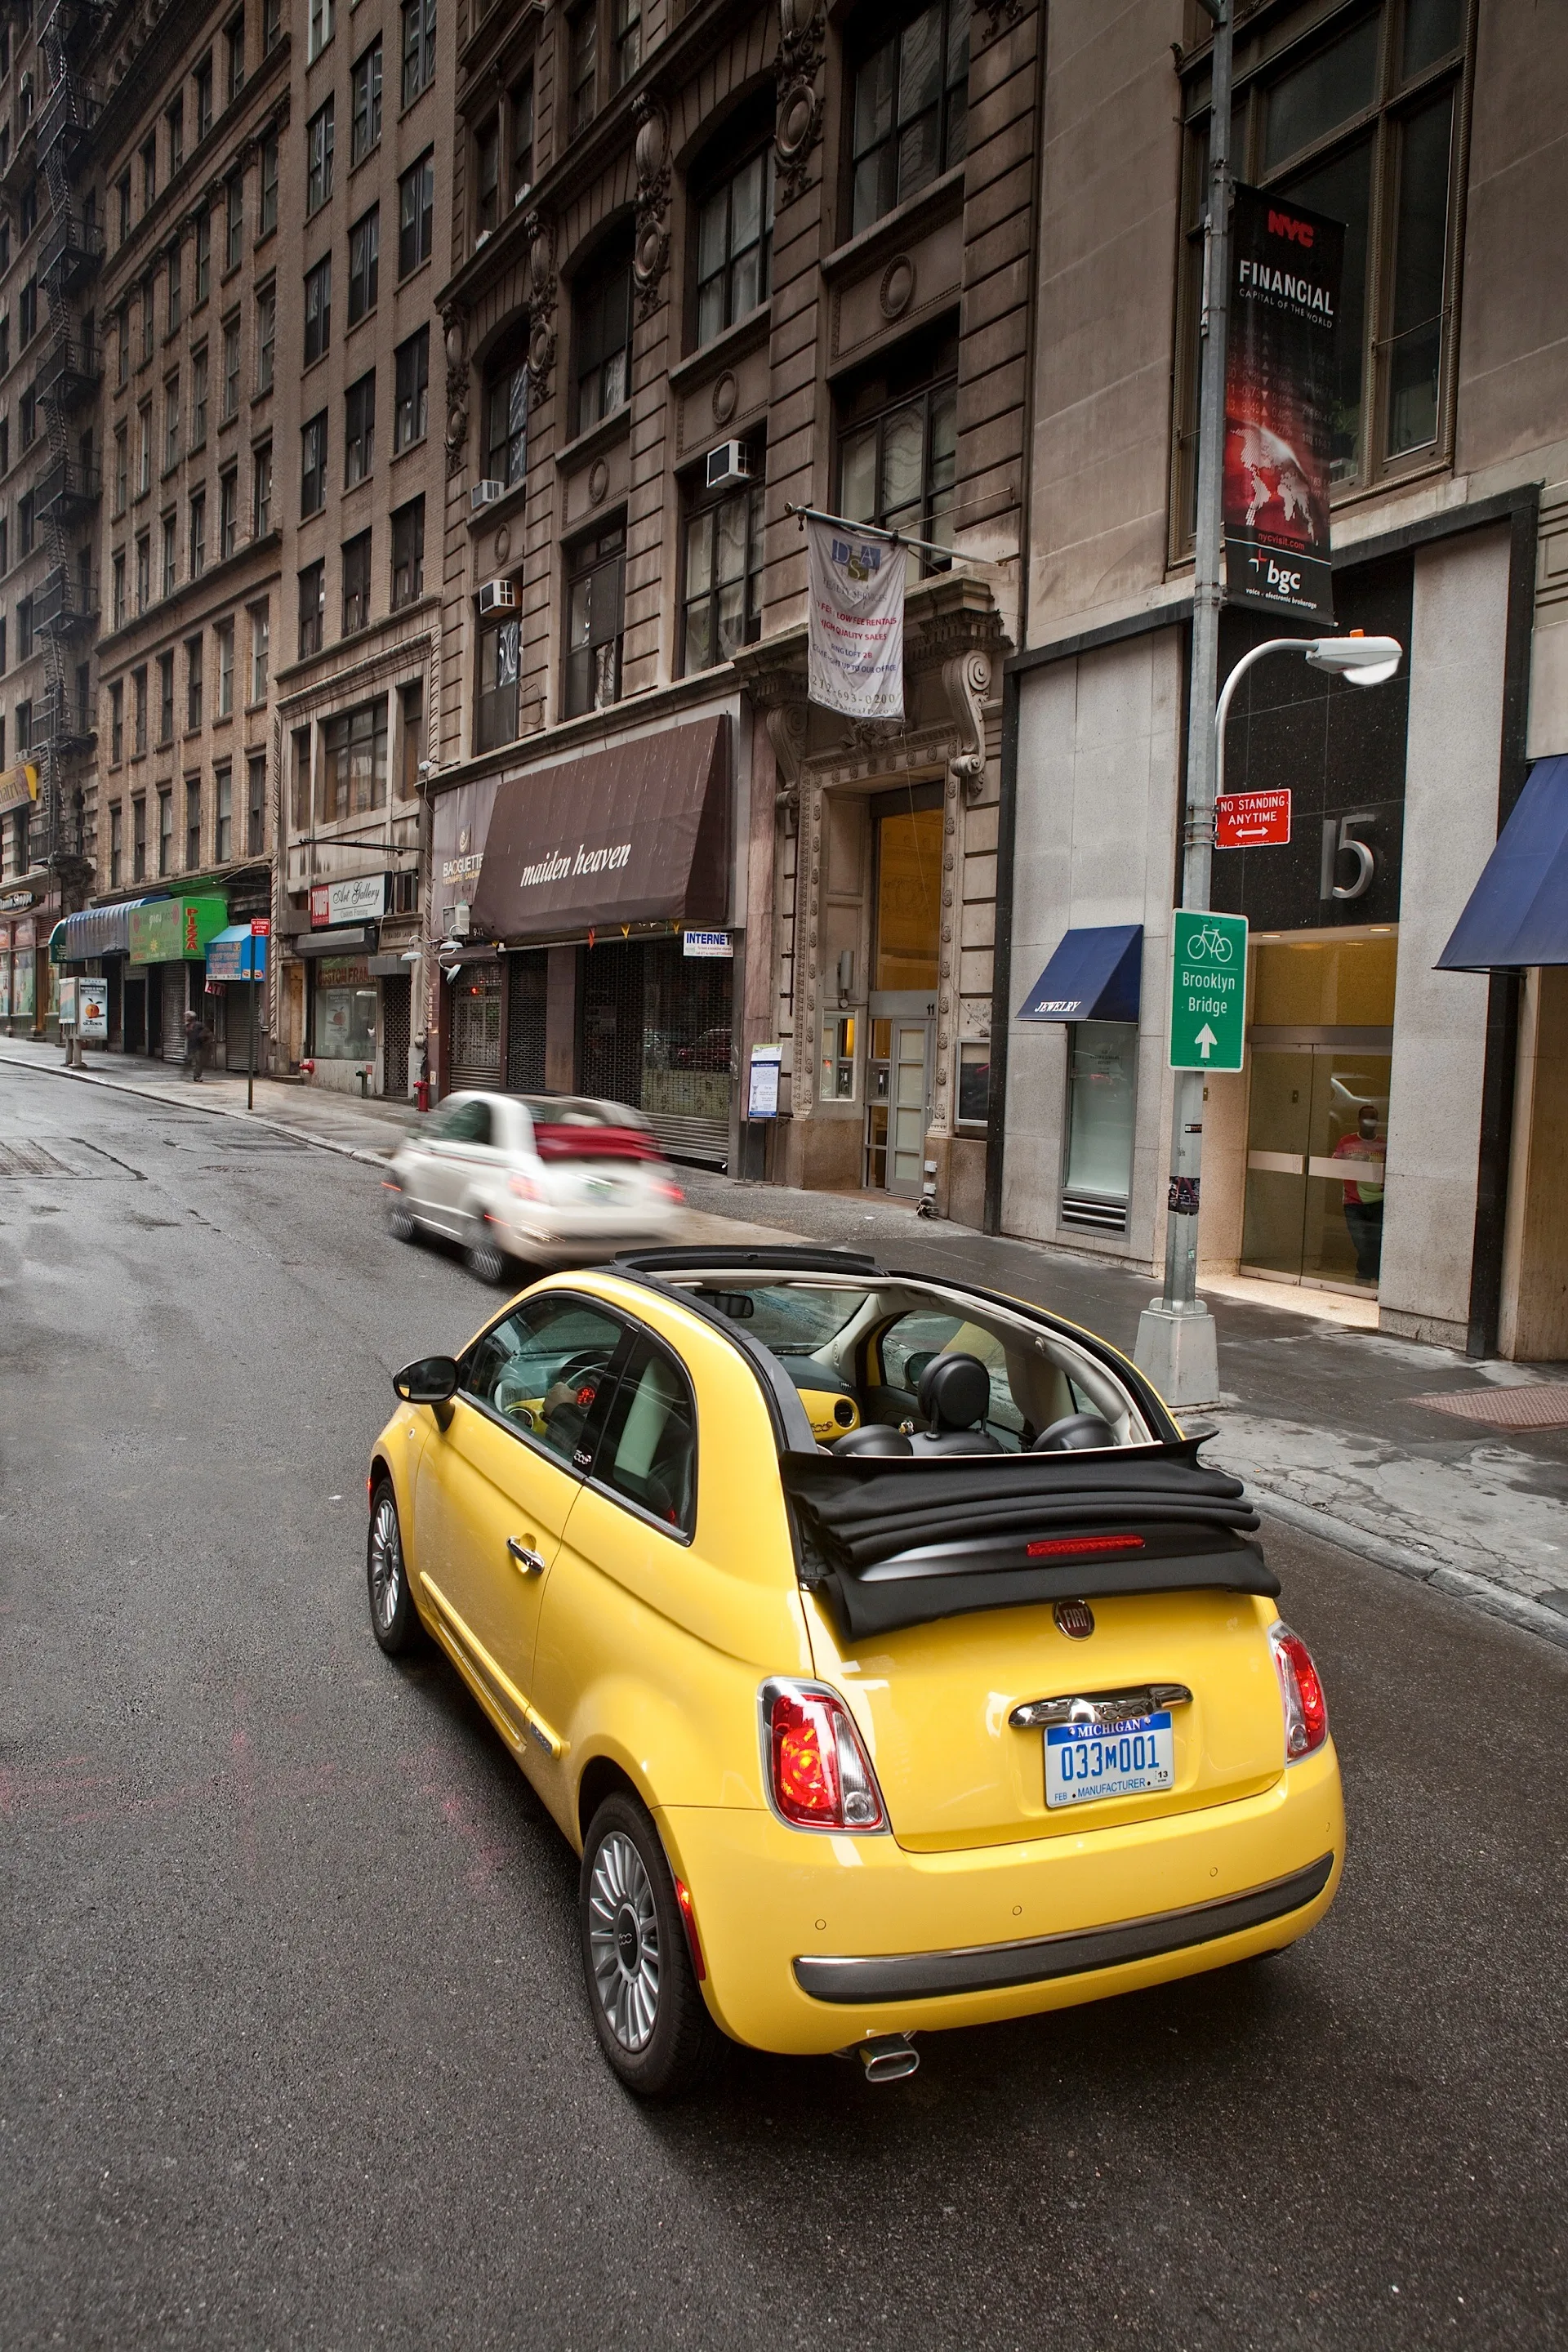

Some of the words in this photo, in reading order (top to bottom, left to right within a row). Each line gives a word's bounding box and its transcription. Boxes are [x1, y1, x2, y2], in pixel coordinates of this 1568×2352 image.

[1268, 210, 1314, 247] NYC
[1240, 259, 1334, 315] FINANCIAL
[1239, 287, 1275, 305] CAPITAL
[1277, 300, 1289, 309] OF
[1291, 304, 1305, 317] THE
[1307, 313, 1332, 328] WORLD
[1258, 532, 1305, 550] nycvisit.com
[1267, 559, 1301, 595] bgc
[1245, 587, 1260, 596] voice
[1265, 591, 1291, 603] electronic
[1292, 596, 1317, 610] brokerage
[837, 612, 853, 623] LOW
[853, 617, 865, 626] FEE
[835, 626, 863, 639] QUALITY
[865, 633, 887, 641] SALES
[845, 649, 861, 657] LOFT
[812, 675, 895, 704] 212-693-0200
[1220, 801, 1234, 813] NO
[1238, 795, 1285, 811] STANDING
[1228, 811, 1277, 826] ANYTIME
[519, 850, 572, 887] maiden
[572, 844, 632, 875] heaven
[1321, 813, 1375, 900] 15
[333, 884, 350, 904] Art
[352, 881, 380, 905] Gallery
[185, 907, 198, 950] PIZZA
[686, 933, 732, 946] INTERNET
[1183, 971, 1236, 991] Brooklyn
[927, 1004, 935, 1015] 11
[1035, 1001, 1081, 1012] JEWELRY
[1187, 996, 1227, 1017] Bridge
[1063, 1609, 1087, 1628] FIAT
[1078, 1718, 1141, 1738] MICHIGAN
[1061, 1735, 1160, 1781] 033M001
[1158, 1771, 1168, 1779] 13
[1054, 1792, 1067, 1802] FEB
[1078, 1777, 1146, 1797] MANUFACTURER
